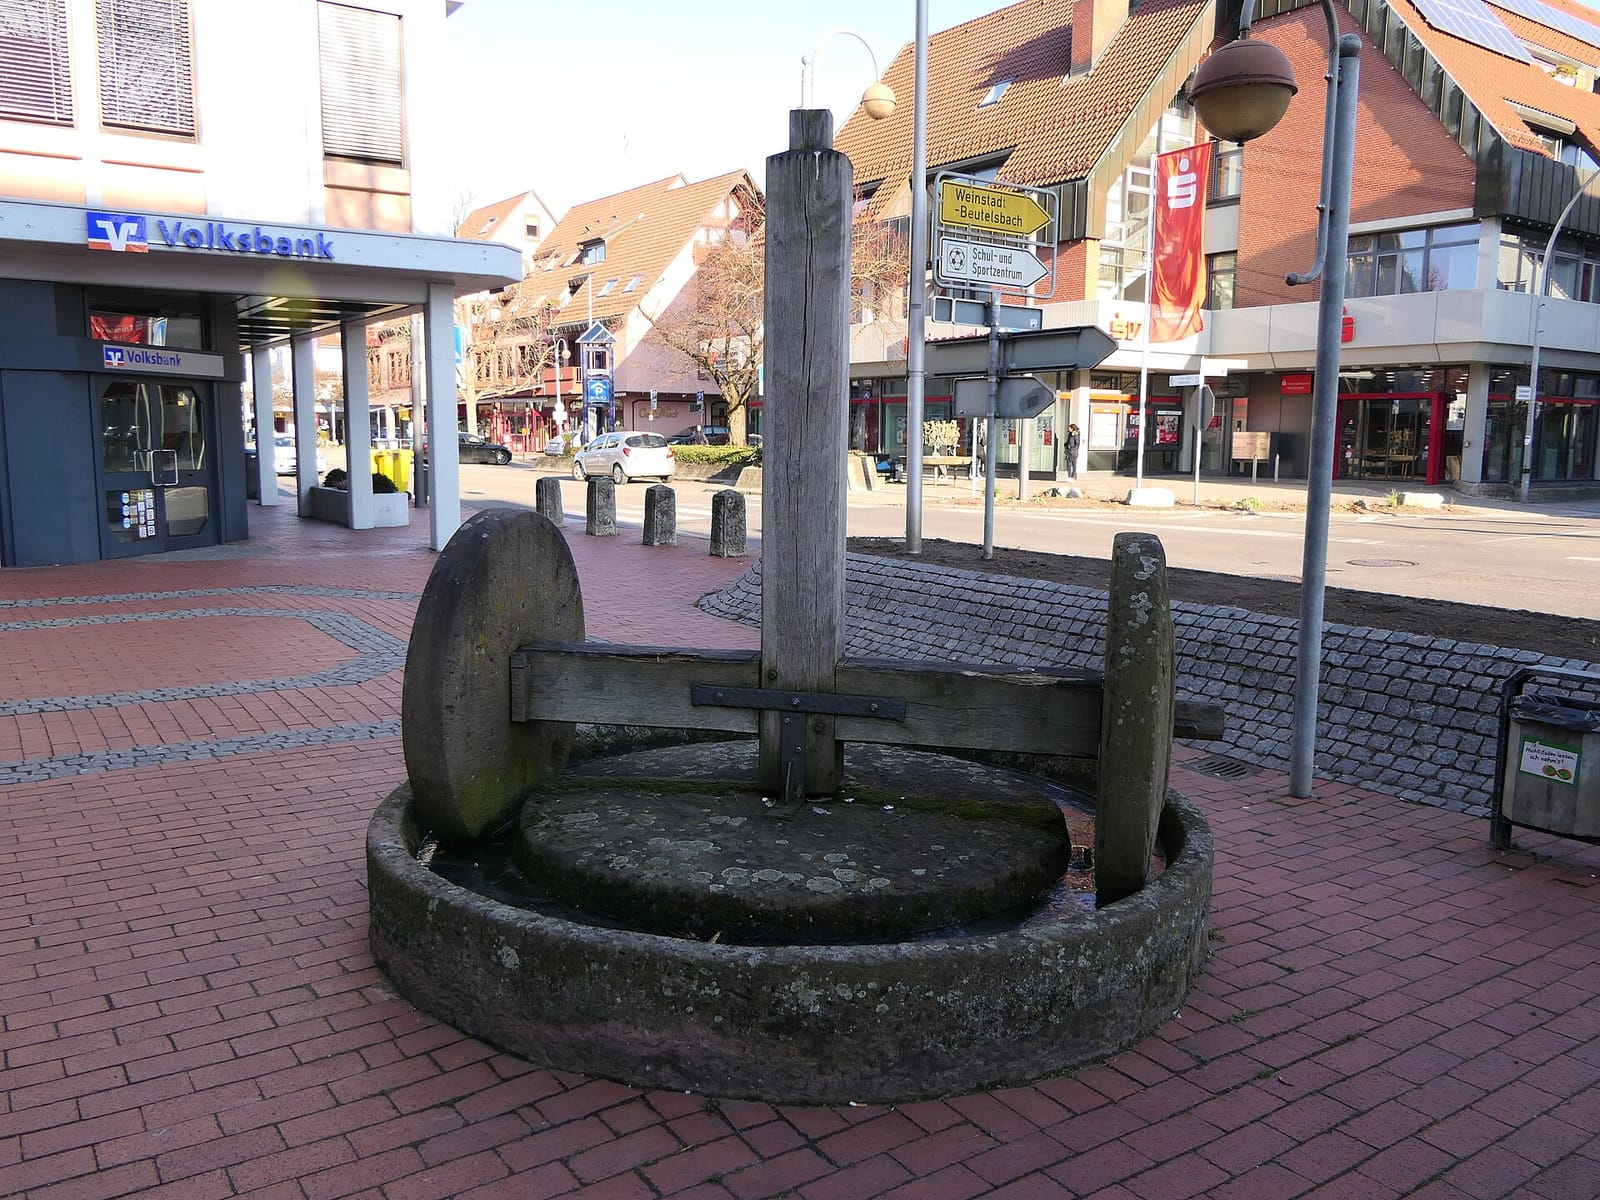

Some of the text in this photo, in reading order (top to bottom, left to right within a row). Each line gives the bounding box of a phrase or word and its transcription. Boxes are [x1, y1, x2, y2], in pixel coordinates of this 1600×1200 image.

[955, 187, 1007, 209] Weinstadt
[157, 219, 336, 261] Volksbank
[972, 262, 1023, 281] Sportzentrum
[126, 350, 182, 367] Volksbank
